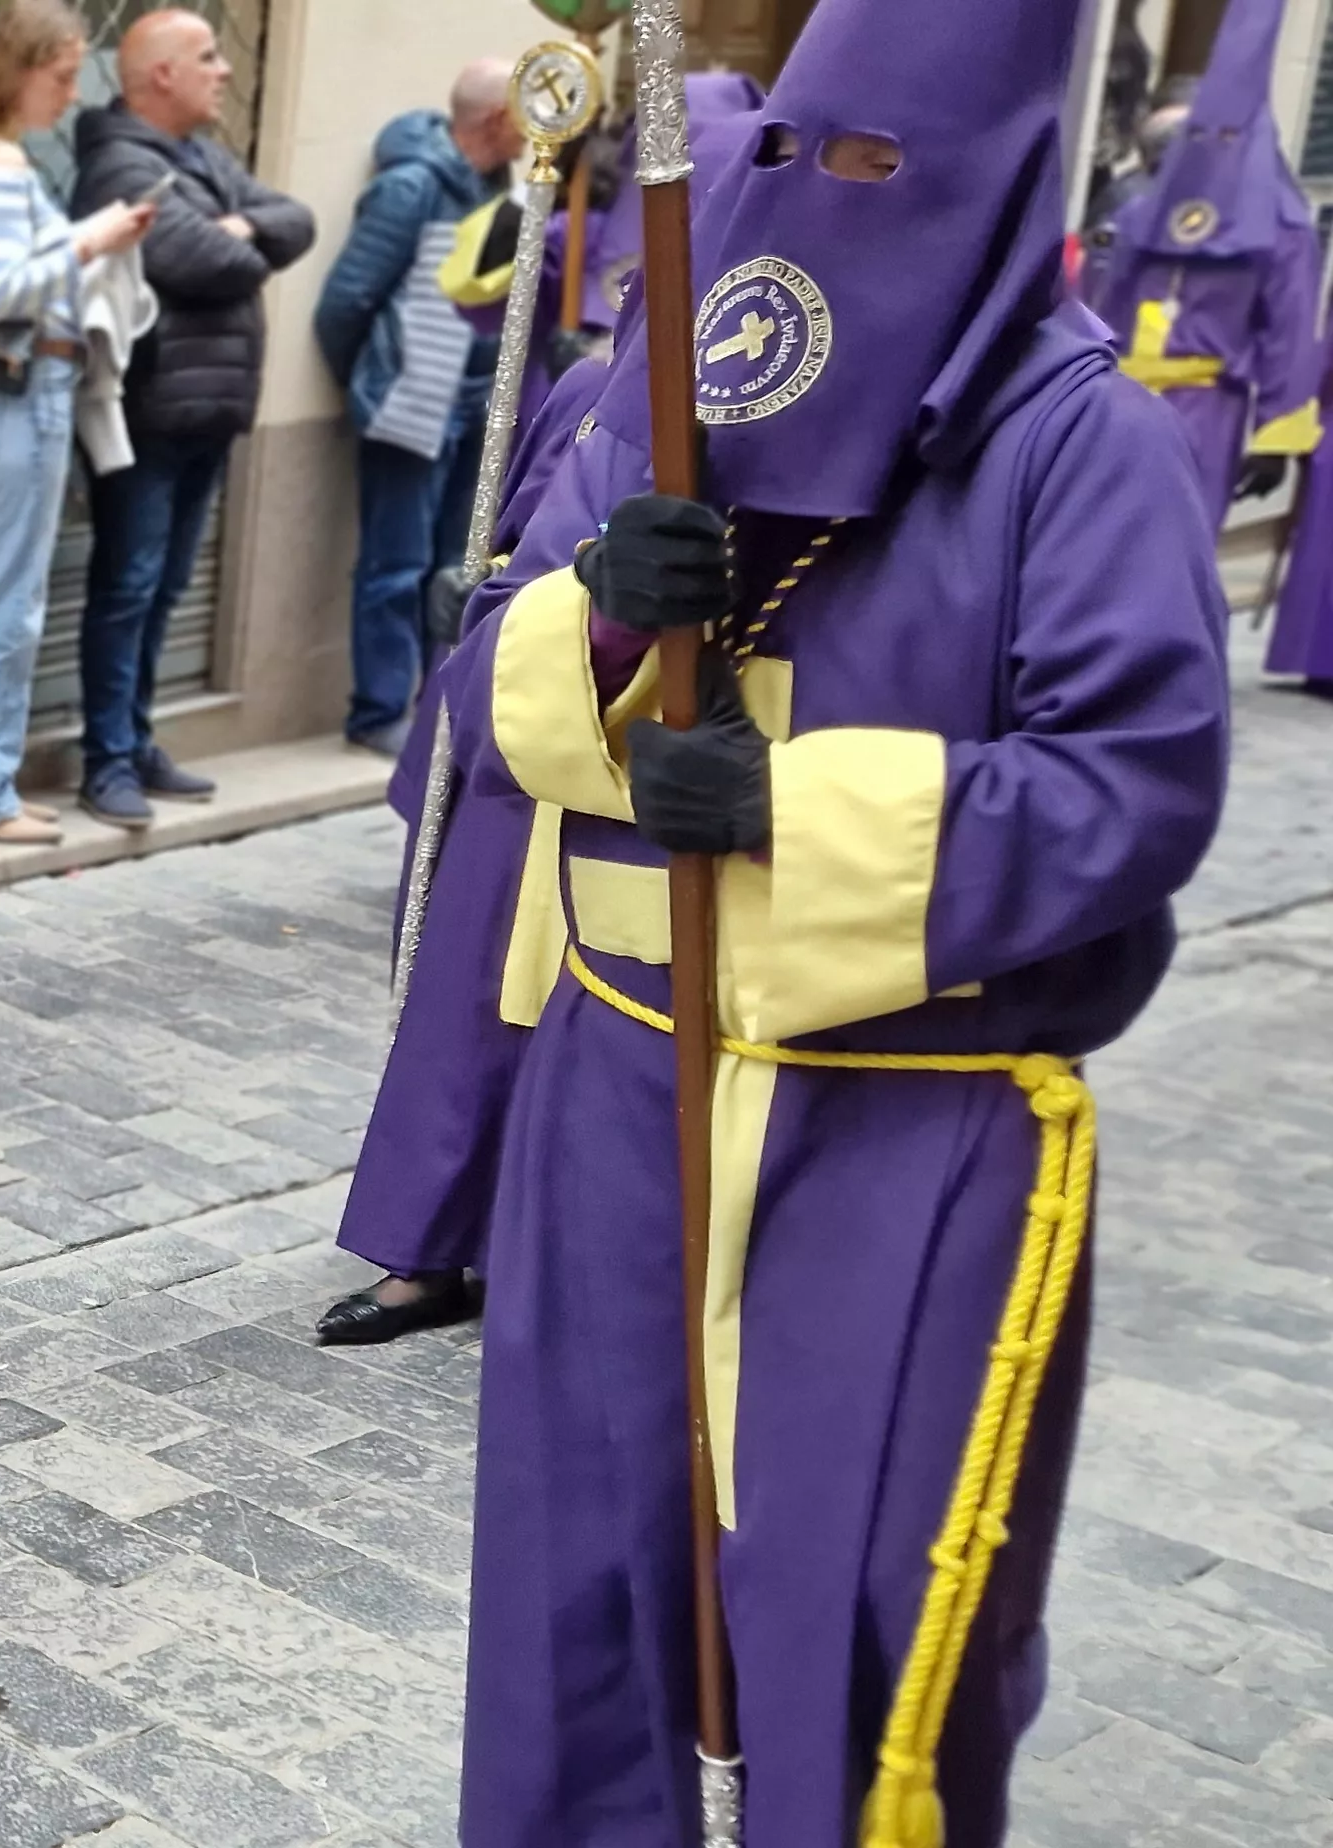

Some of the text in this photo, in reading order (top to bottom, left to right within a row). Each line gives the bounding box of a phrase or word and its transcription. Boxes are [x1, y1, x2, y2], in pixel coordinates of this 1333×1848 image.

[764, 284, 790, 314] Rex
[783, 269, 823, 309] PADRE
[811, 311, 828, 352] JESUS
[747, 357, 822, 417] NAZARENO
